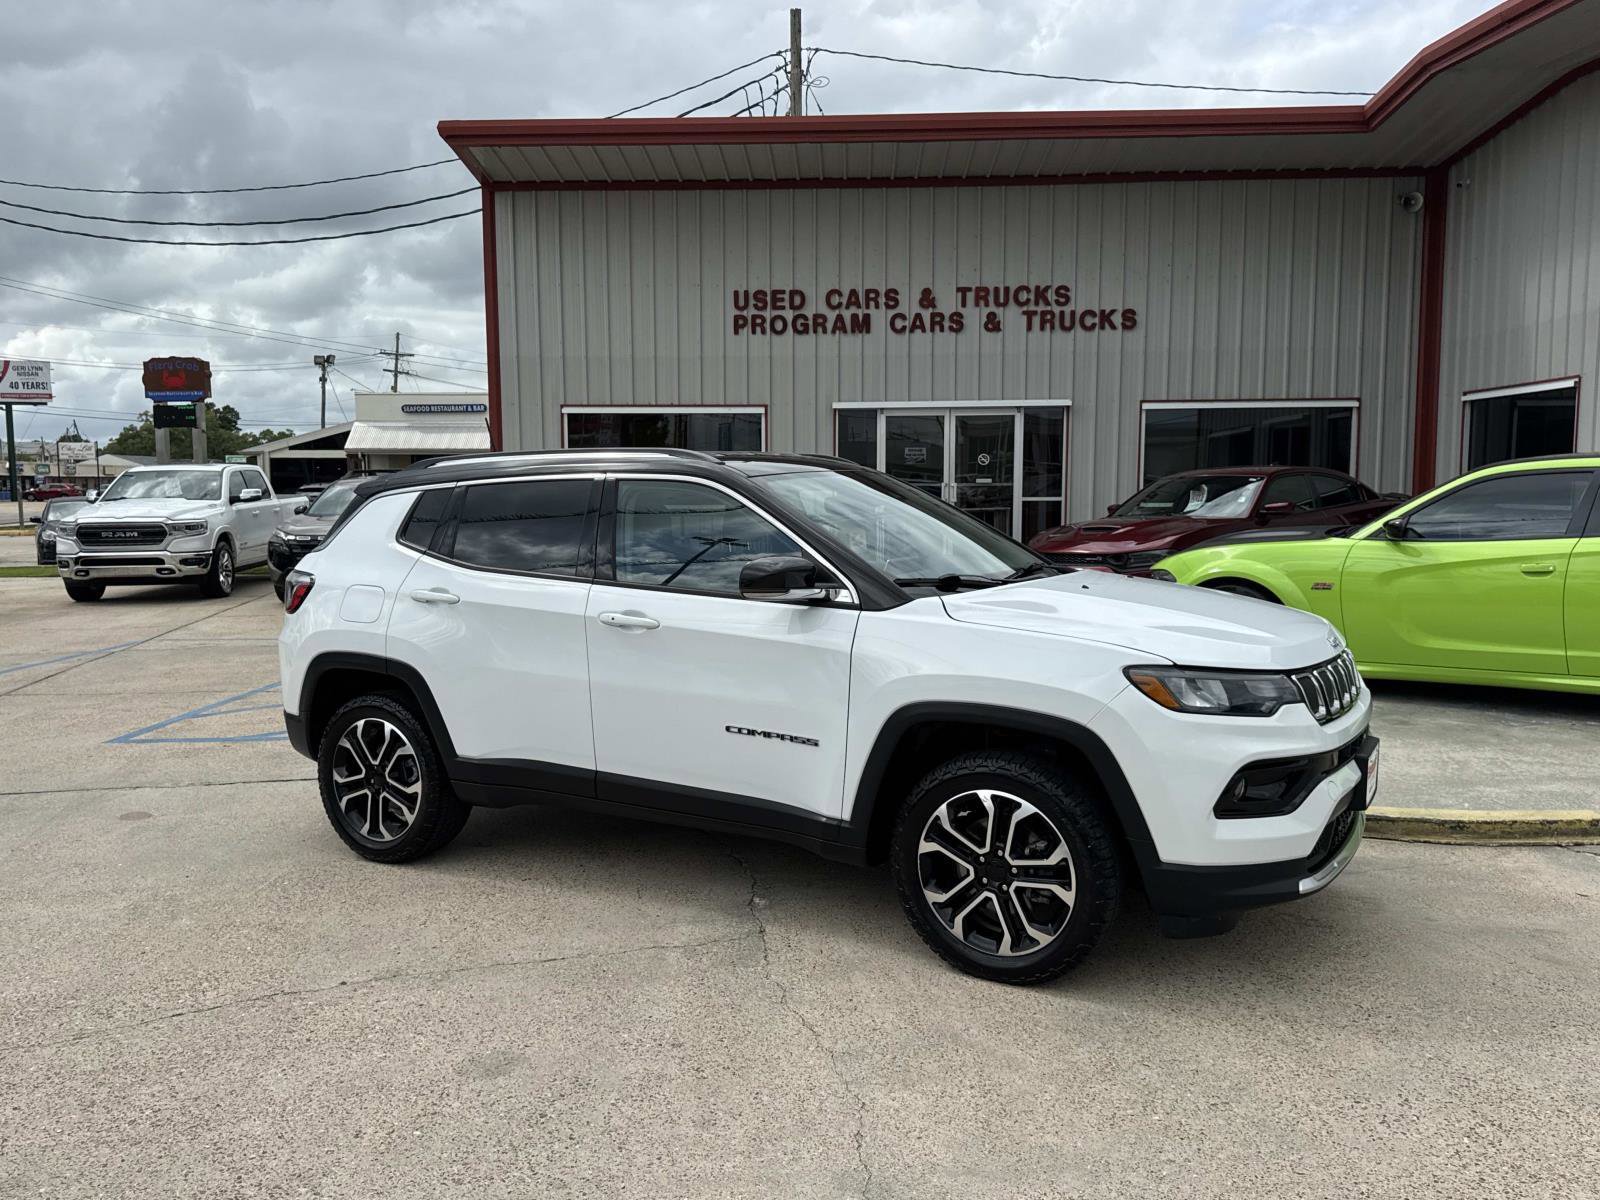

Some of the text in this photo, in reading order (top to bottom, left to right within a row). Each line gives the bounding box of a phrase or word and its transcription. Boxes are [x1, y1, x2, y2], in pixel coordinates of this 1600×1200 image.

[733, 284, 1071, 311] USED CARS & TRUCKS
[733, 308, 1138, 335] PROGRAM CARS & TRUCKS
[9, 381, 49, 391] 40 YEARS!
[725, 725, 820, 747] COMPASS
